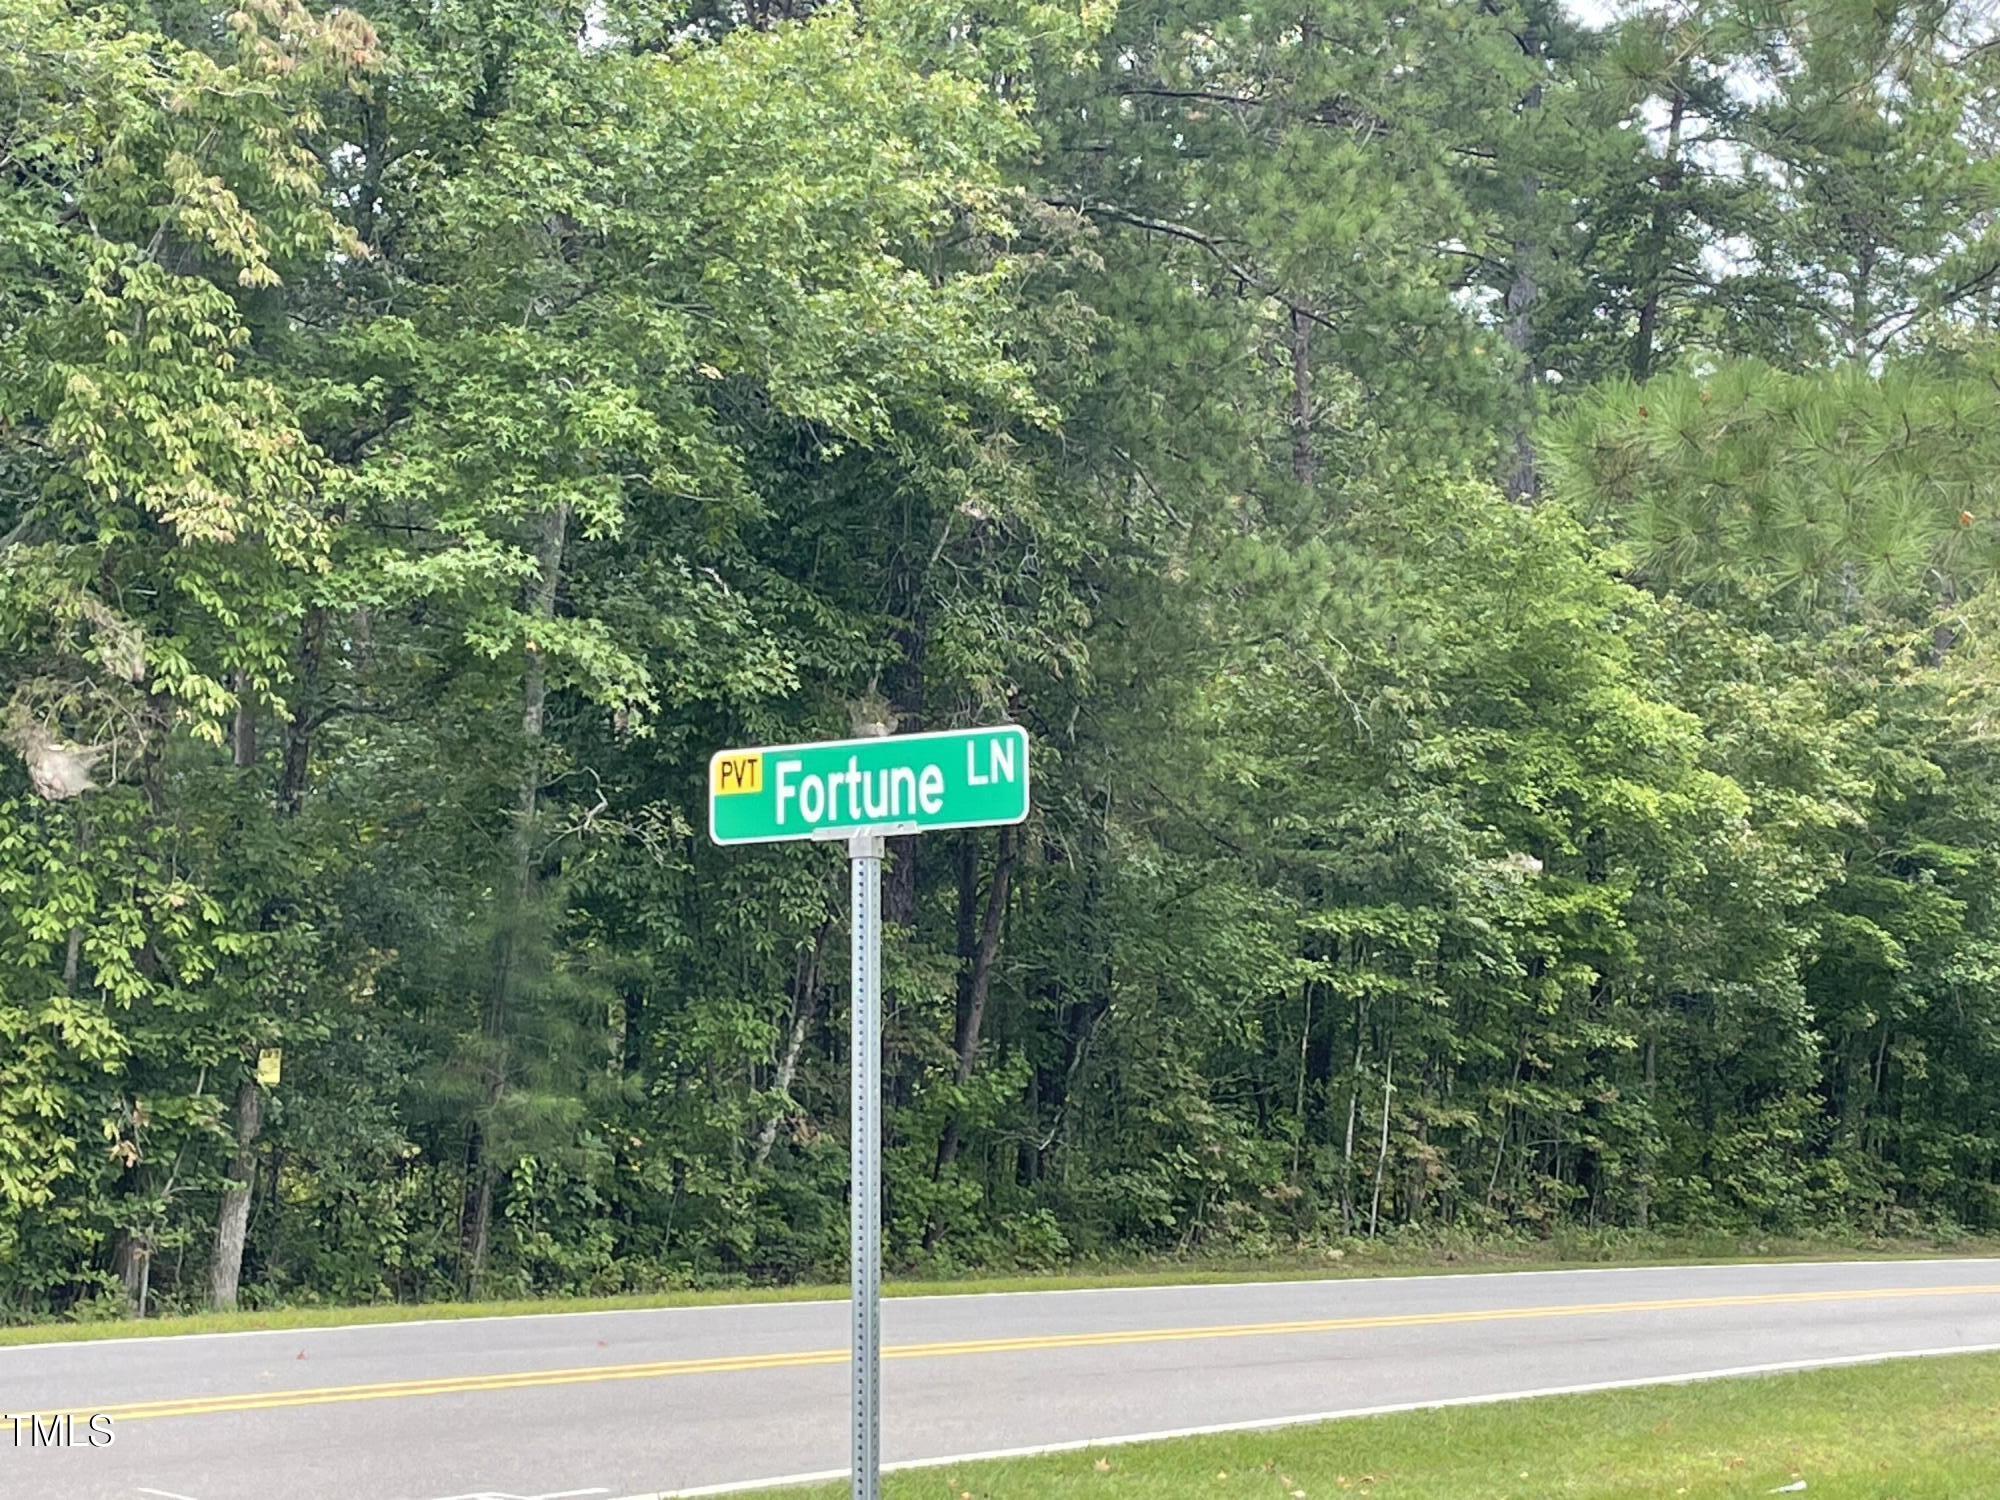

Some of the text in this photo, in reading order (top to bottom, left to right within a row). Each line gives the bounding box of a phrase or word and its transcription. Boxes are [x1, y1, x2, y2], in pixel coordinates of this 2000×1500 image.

[720, 737, 1015, 825] PVT Fortune LN
